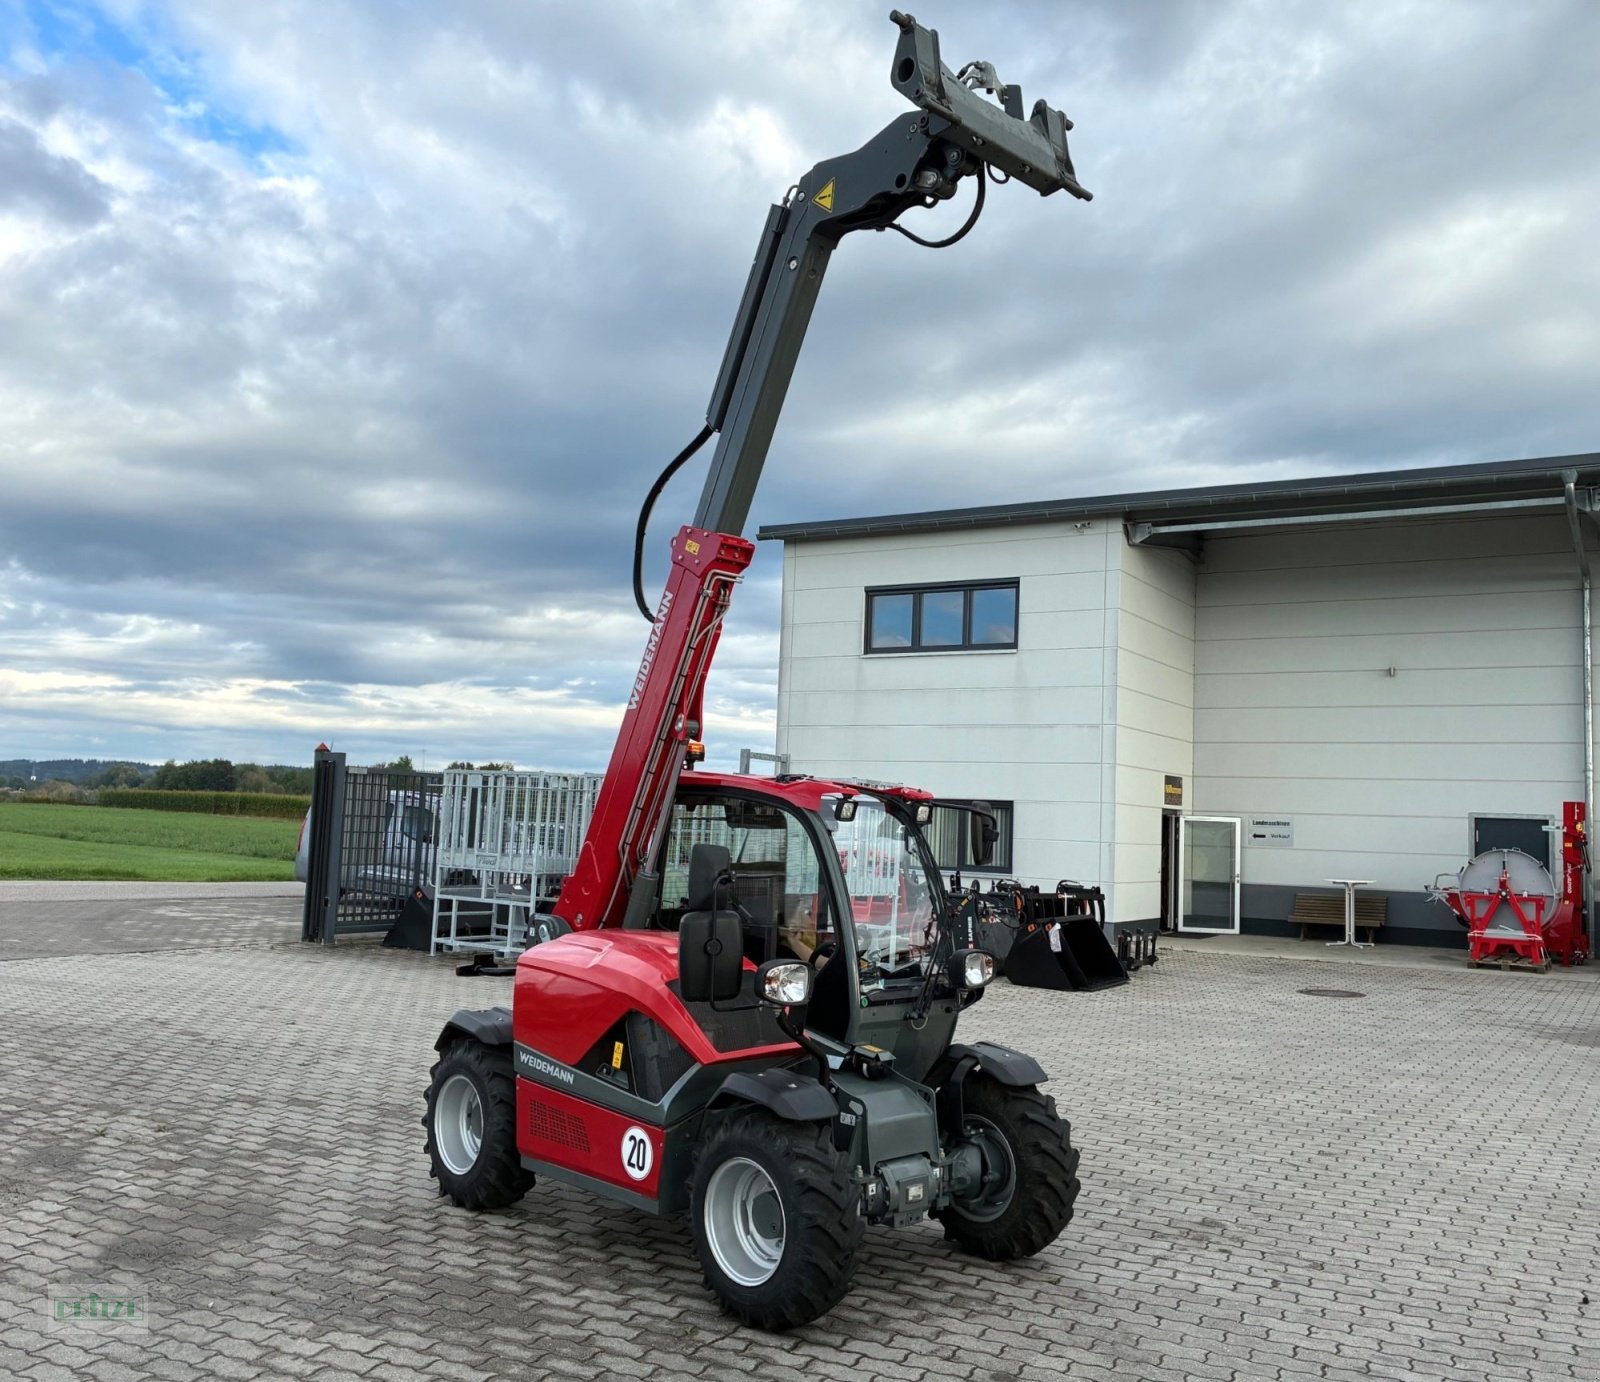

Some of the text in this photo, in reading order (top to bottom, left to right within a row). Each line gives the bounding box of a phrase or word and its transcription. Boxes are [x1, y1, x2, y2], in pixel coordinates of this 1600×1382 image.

[627, 590, 674, 710] WEIDEMANN
[519, 1051, 575, 1085] WEIDEMANN
[627, 1134, 647, 1172] 20
